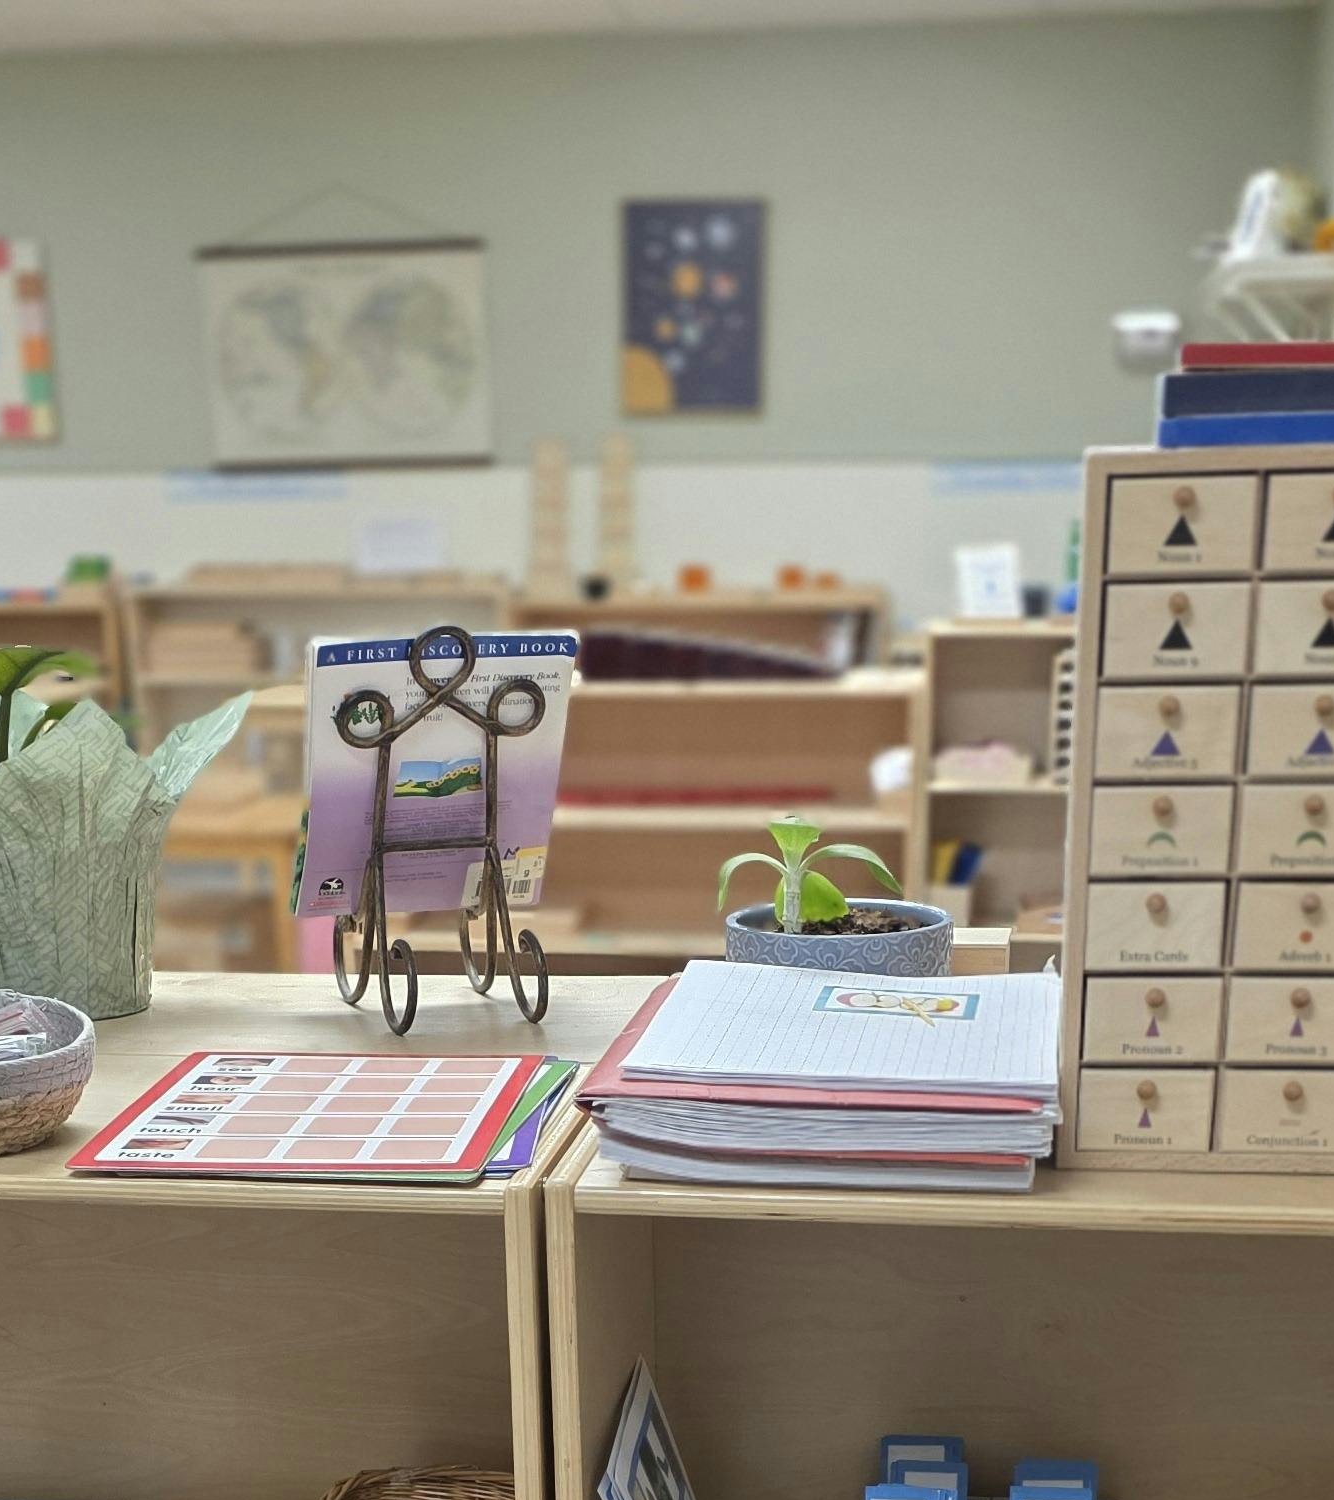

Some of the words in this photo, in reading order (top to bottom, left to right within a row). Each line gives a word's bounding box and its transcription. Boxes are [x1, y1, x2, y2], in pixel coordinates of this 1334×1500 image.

[326, 652, 336, 663] A
[347, 647, 398, 662] FIRST
[519, 642, 569, 654] BOOK
[1119, 950, 1153, 964] Extra
[1155, 950, 1189, 965] Cards
[1121, 1043, 1173, 1056] Pronoun
[1264, 1043, 1317, 1057] Pronoun
[139, 1127, 202, 1135] touch
[1113, 1133, 1165, 1146] Pronoun
[1246, 1133, 1320, 1149] Conjunction
[117, 1151, 176, 1159] taste
